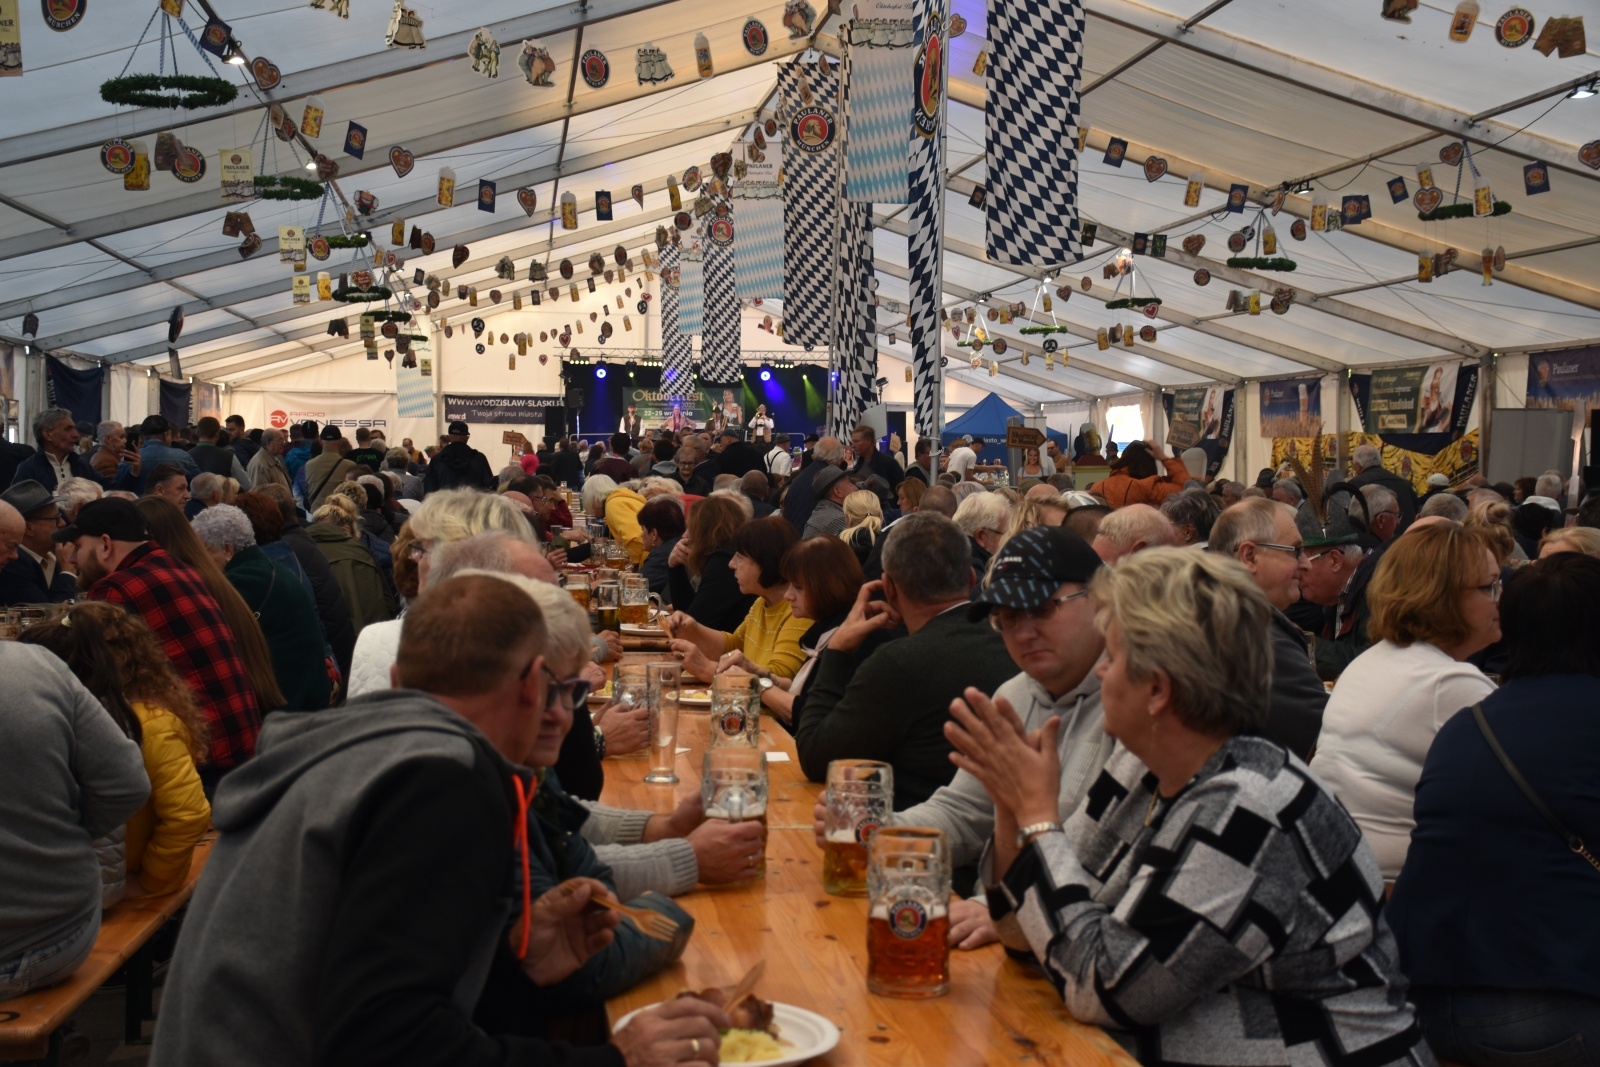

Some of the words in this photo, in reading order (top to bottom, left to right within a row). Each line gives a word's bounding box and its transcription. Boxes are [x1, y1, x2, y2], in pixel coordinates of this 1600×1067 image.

[793, 108, 833, 125] PAULANER
[1456, 374, 1477, 427] PAULANER
[290, 419, 387, 427] VNESSA
